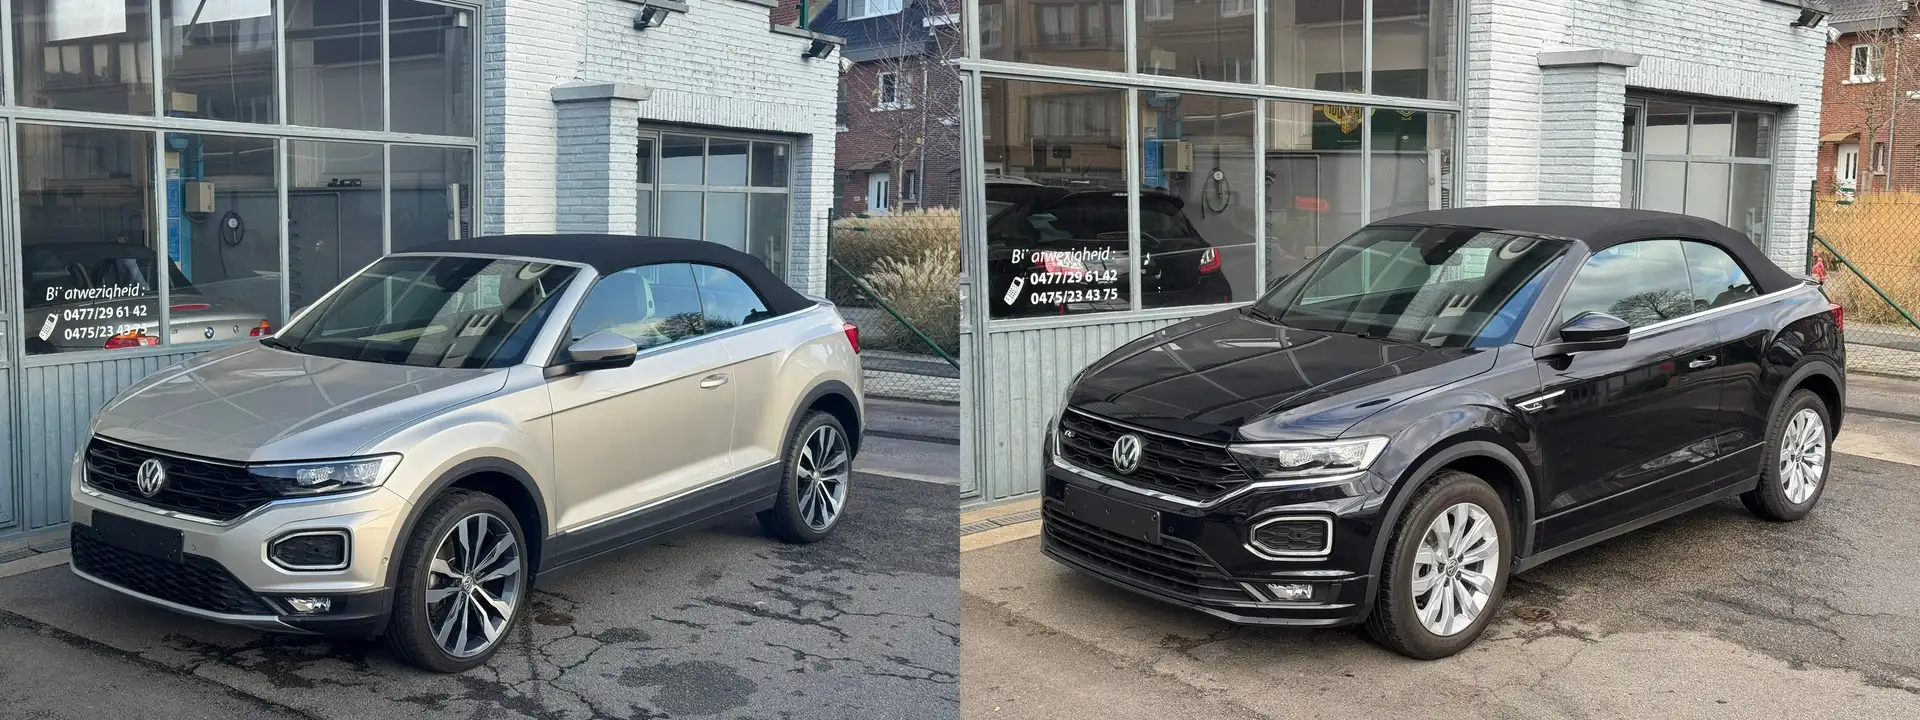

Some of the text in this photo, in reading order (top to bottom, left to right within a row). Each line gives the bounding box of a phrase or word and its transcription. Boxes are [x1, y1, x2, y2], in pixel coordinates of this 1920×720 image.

[1011, 249, 1029, 264] Bi
[1030, 269, 1117, 285] 0477/29 61 42
[46, 286, 63, 301] Bi
[1031, 288, 1118, 305] 0475/23 43 75
[63, 305, 147, 321] 0477/29 61 42
[64, 323, 148, 340] 0475/23 43 75
[1113, 435, 1142, 474] VW
[137, 459, 164, 497] VW
